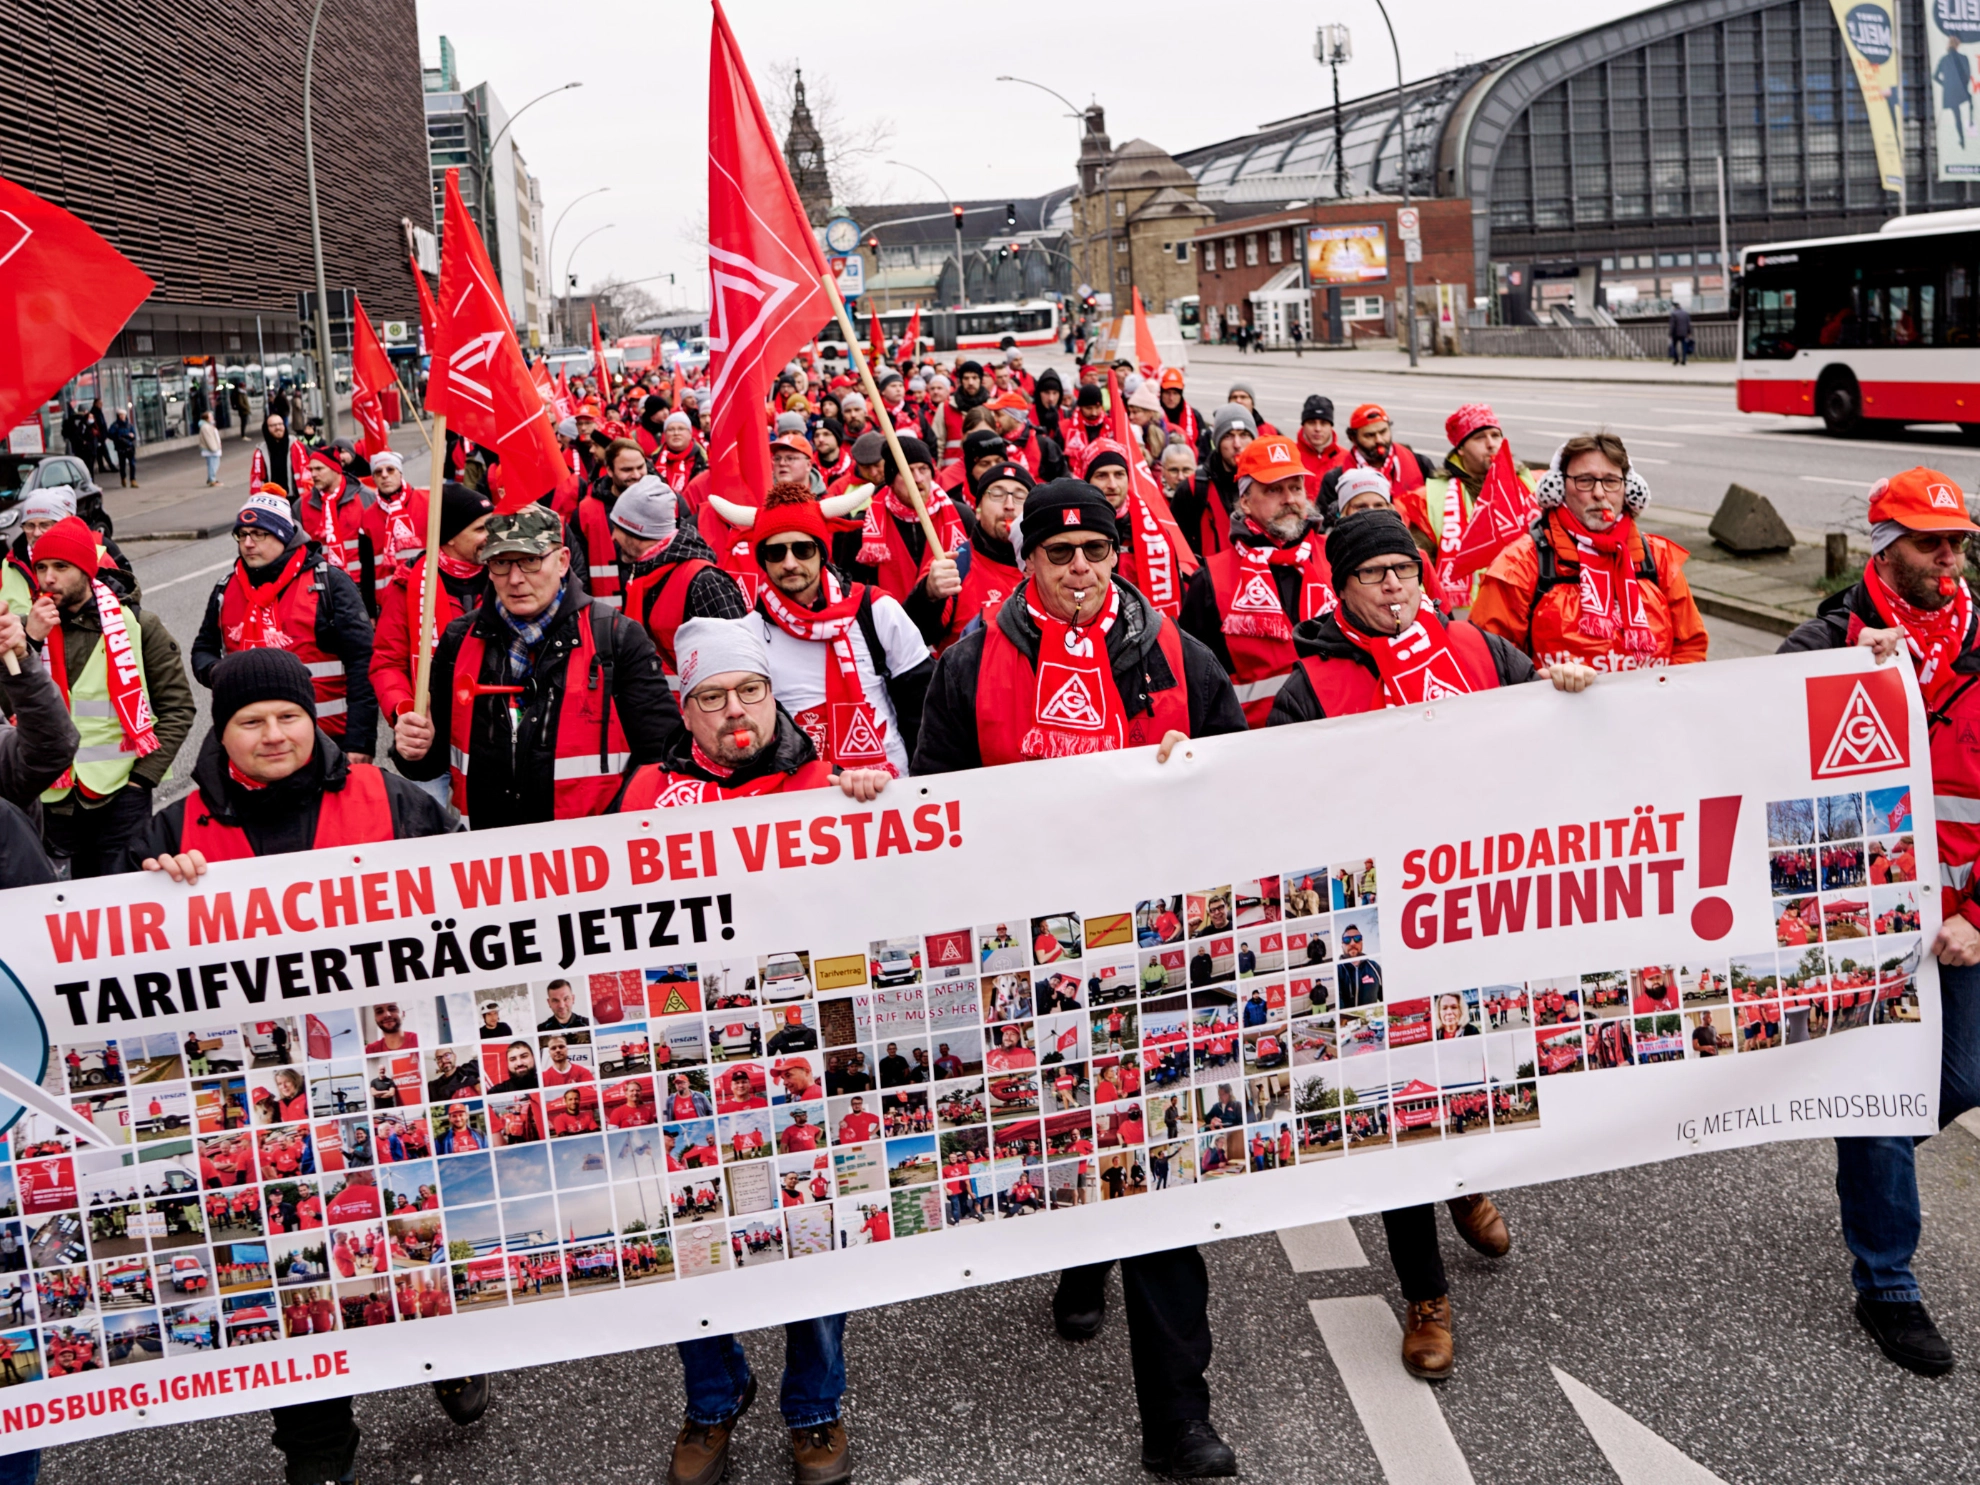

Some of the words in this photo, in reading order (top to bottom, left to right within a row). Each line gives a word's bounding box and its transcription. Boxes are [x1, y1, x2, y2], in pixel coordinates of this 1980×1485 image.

[1043, 678, 1099, 723] IGM
[1826, 691, 1897, 769] IGM
[844, 711, 885, 754] IGM
[1401, 804, 1685, 890] SOLIDARITÄT
[45, 901, 171, 964] WIR
[187, 866, 436, 946] MACHEN
[450, 845, 610, 909] WIND
[627, 830, 718, 885] BEI
[732, 800, 963, 873] VESTAS!
[1400, 858, 1685, 950] GEWINNT
[55, 917, 542, 1026] TARIFVERTRÄGE
[558, 893, 735, 970] JETZT!
[820, 967, 862, 979] Tarifvertrag
[897, 989, 923, 1001] FÜR
[935, 981, 975, 996] MEHR
[905, 1007, 944, 1021] MUSS
[952, 1003, 977, 1016] HER
[1677, 1119, 1696, 1141] IG
[1703, 1103, 1782, 1136] METALL
[1789, 1093, 1928, 1122] RENDSBURG
[0, 1350, 350, 1435] NDSBURG.IGMETALL.DE
